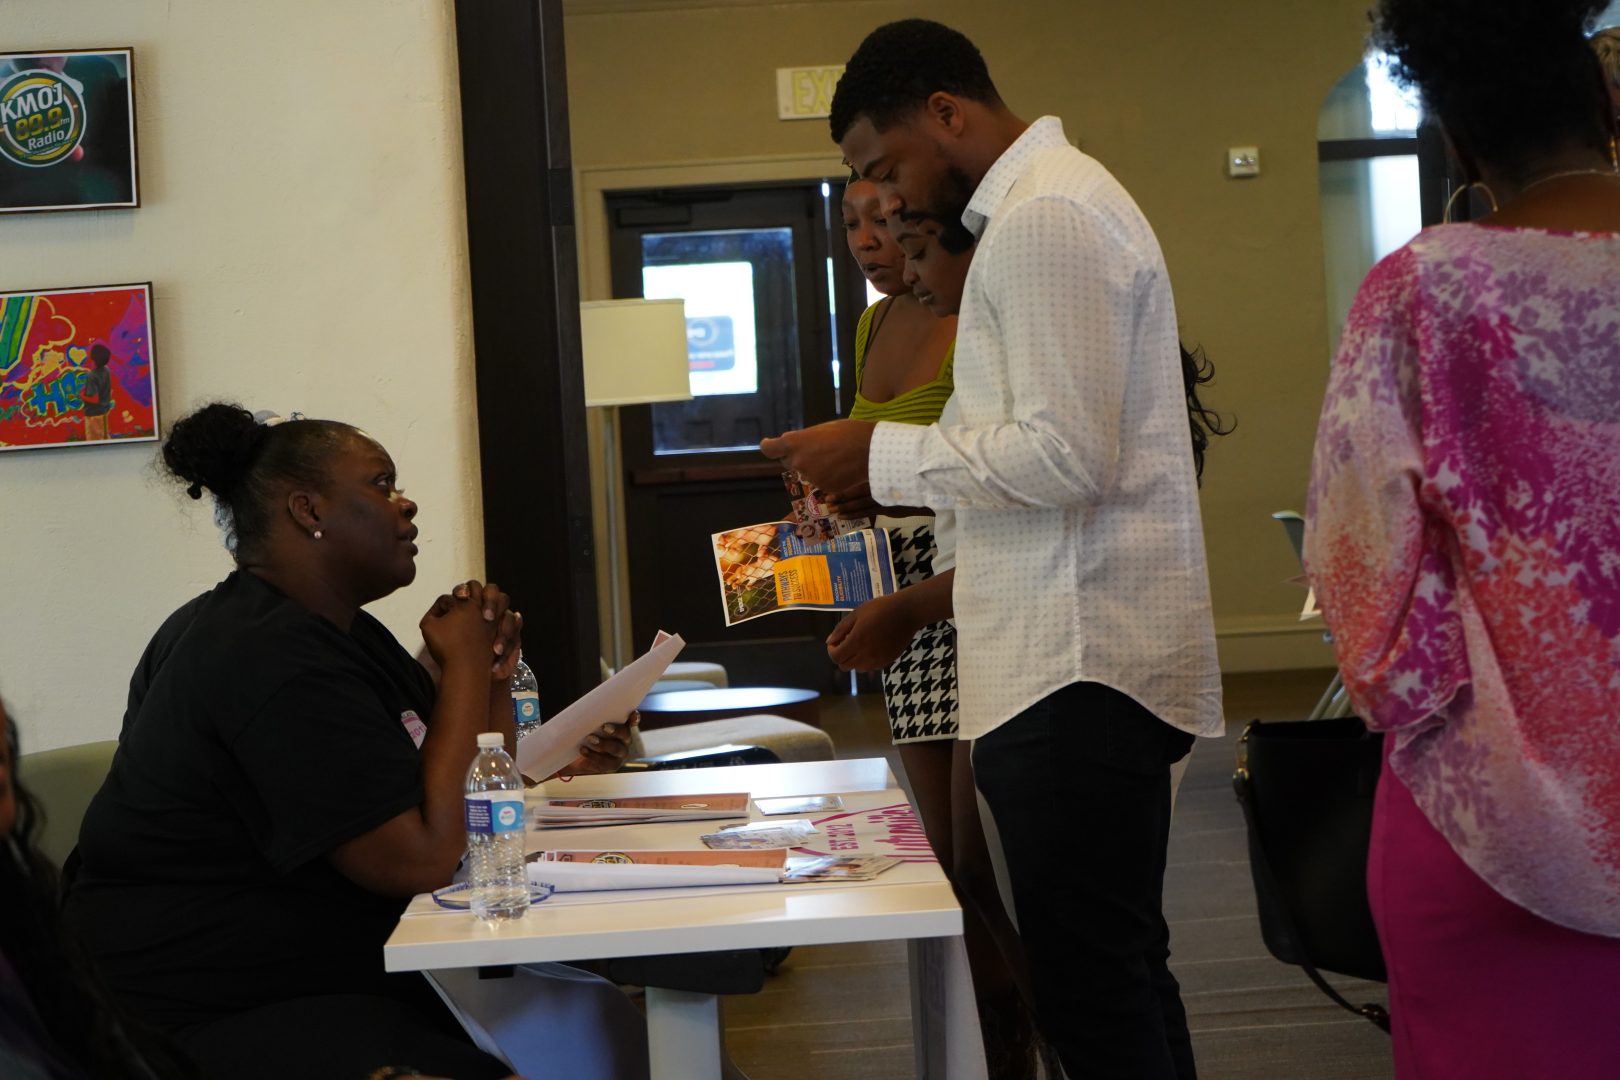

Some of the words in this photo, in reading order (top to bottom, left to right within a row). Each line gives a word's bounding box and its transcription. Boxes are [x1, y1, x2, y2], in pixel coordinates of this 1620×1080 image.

[0, 83, 63, 123] KMOJ
[793, 69, 845, 113] EXI
[15, 107, 62, 140] 89.9
[28, 130, 65, 150] Radio
[778, 571, 792, 601] PATHWAYS
[789, 569, 801, 593] SUCCESS
[792, 592, 802, 600] TO
[828, 838, 859, 850] EST.
